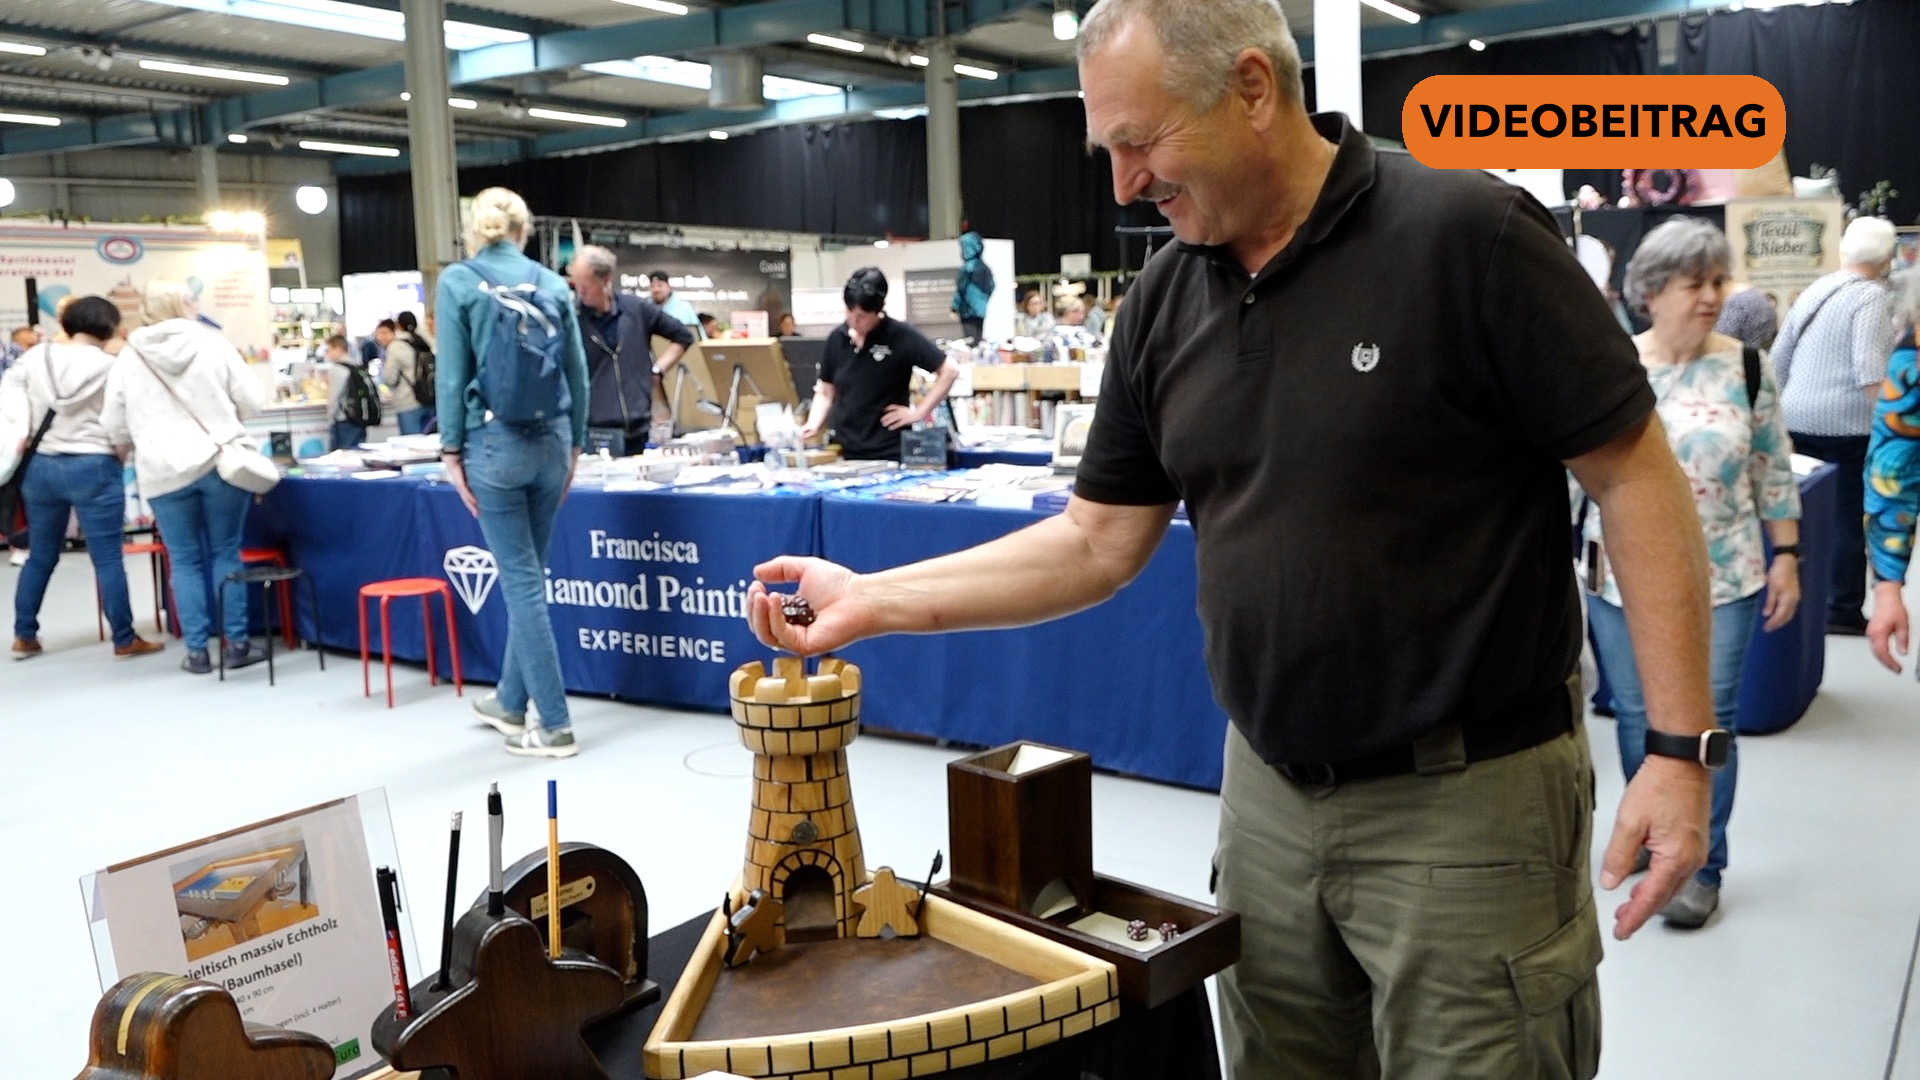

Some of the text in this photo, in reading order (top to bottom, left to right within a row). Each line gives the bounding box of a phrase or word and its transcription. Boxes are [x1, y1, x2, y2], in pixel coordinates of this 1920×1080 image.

[589, 529, 699, 564] Francisca
[544, 567, 748, 619] iamond Painti
[578, 628, 726, 663] EXPERIENCE
[183, 918, 338, 979] ieltisch massiv Echtholz
[223, 952, 303, 991] (Baumhasel)
